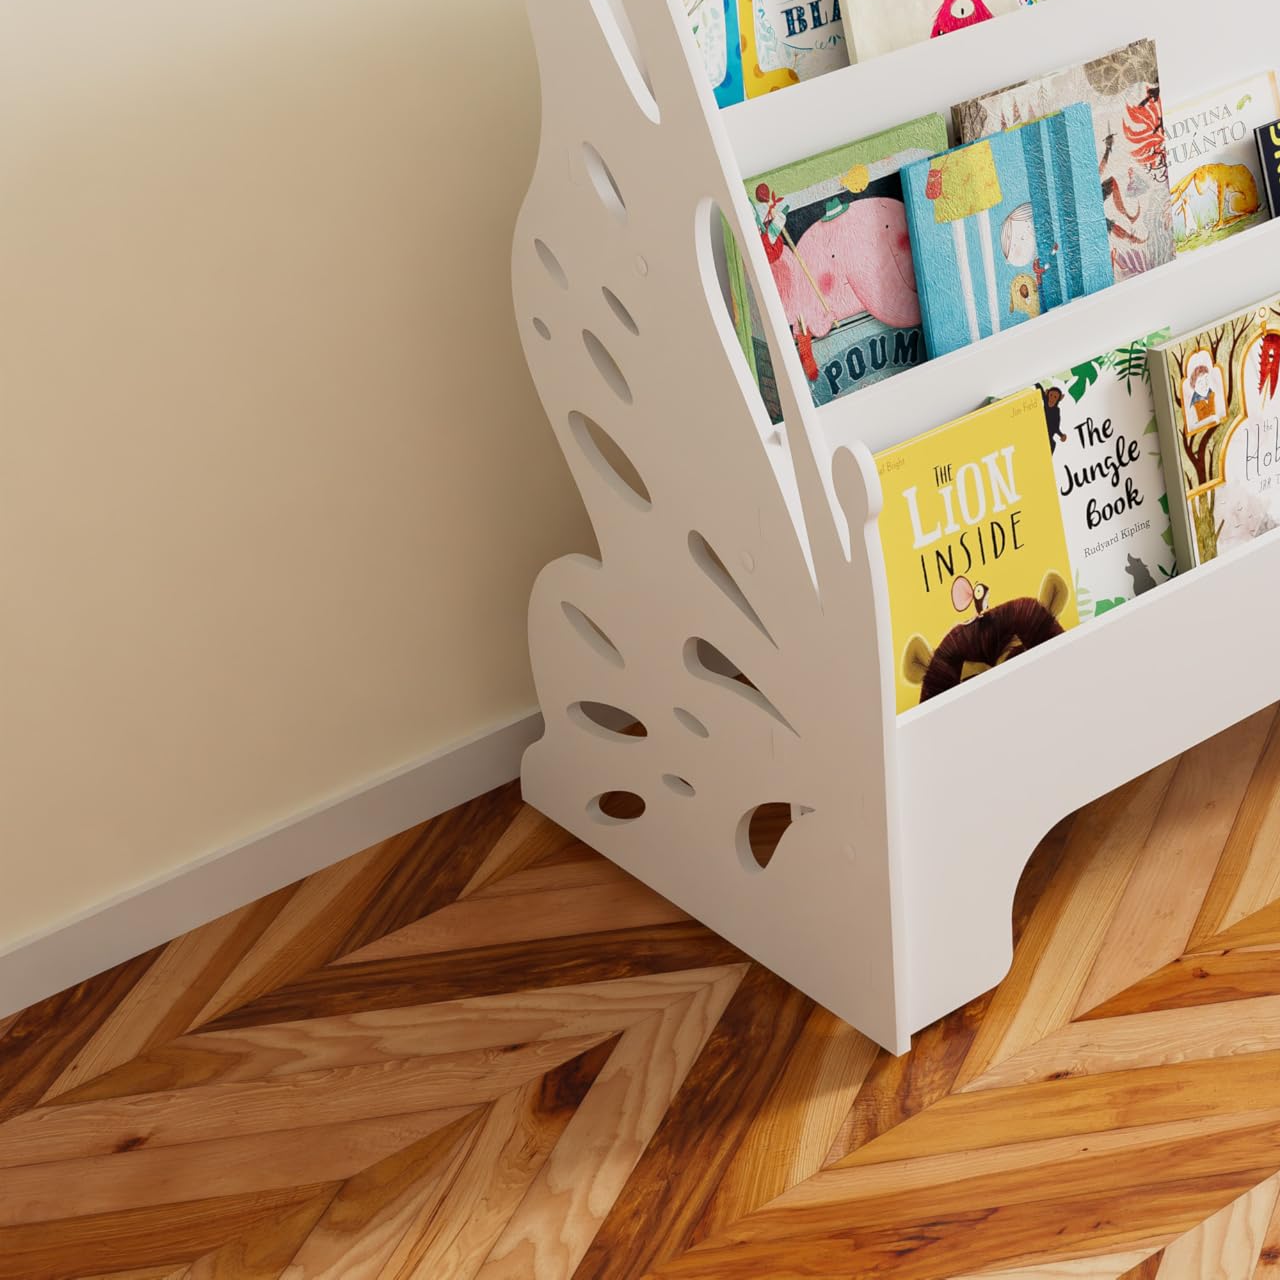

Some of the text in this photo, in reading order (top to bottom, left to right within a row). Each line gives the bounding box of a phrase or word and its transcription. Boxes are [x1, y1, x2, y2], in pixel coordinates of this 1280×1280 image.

[1167, 120, 1247, 167] UÁNTO
[823, 329, 920, 395] POUM
[1074, 417, 1114, 449] The
[934, 463, 954, 488] THE
[1060, 435, 1141, 497] Jungle
[902, 444, 1023, 550] LION
[920, 510, 1025, 593] INSIDE
[1083, 519, 1151, 558] Rudyard Kipling
